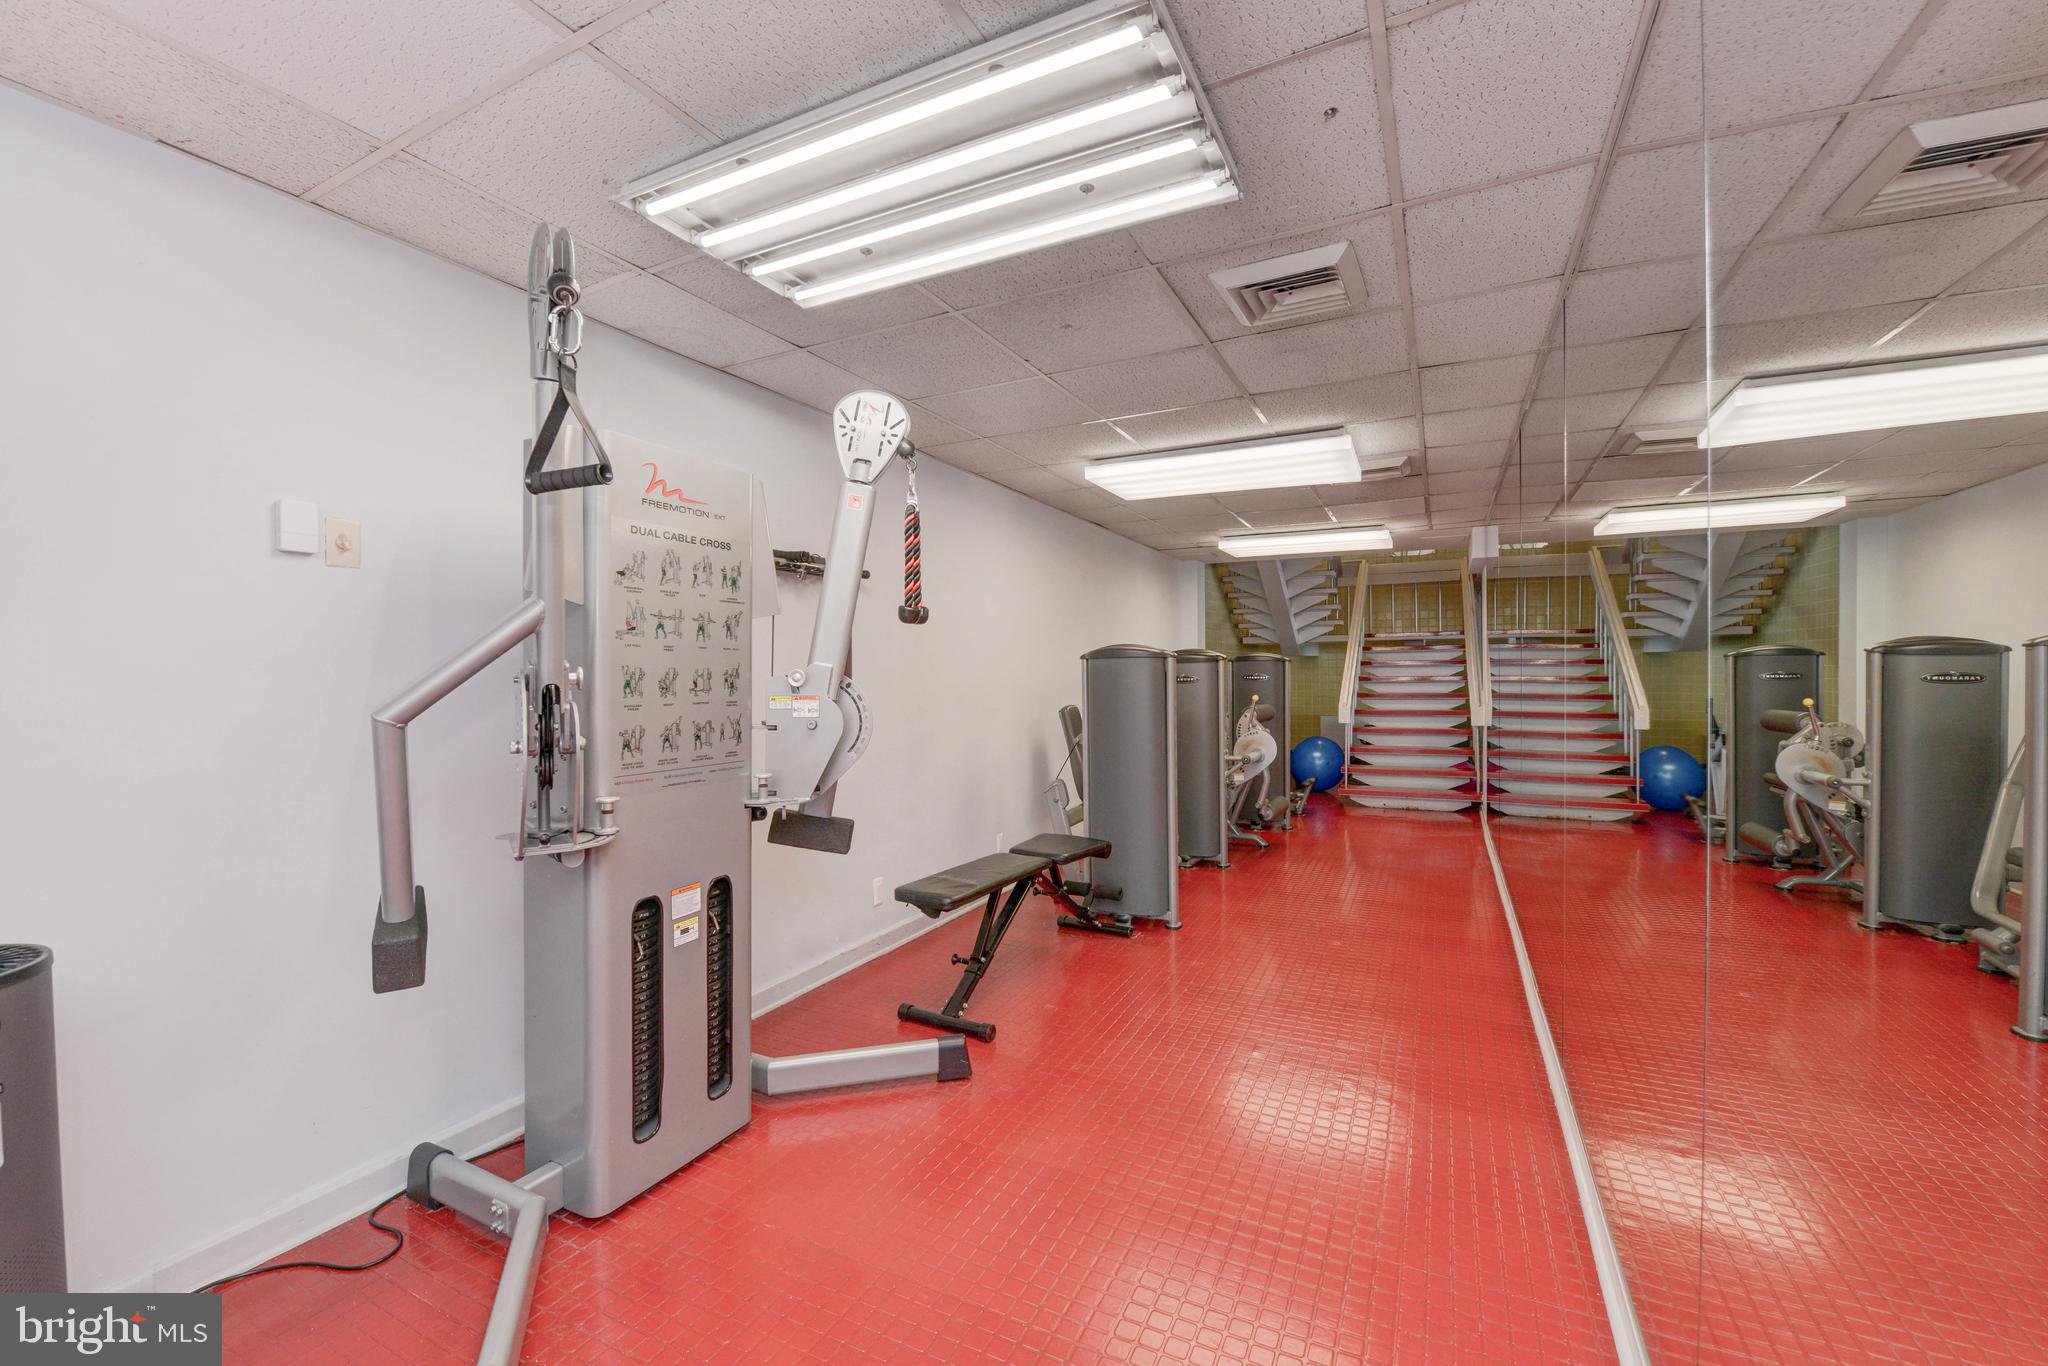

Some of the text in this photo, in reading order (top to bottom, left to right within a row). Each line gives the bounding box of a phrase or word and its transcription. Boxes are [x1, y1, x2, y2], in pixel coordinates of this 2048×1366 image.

[641, 497, 710, 519] FREEMOTION
[630, 524, 732, 551] DUAL CABLE CROSS
